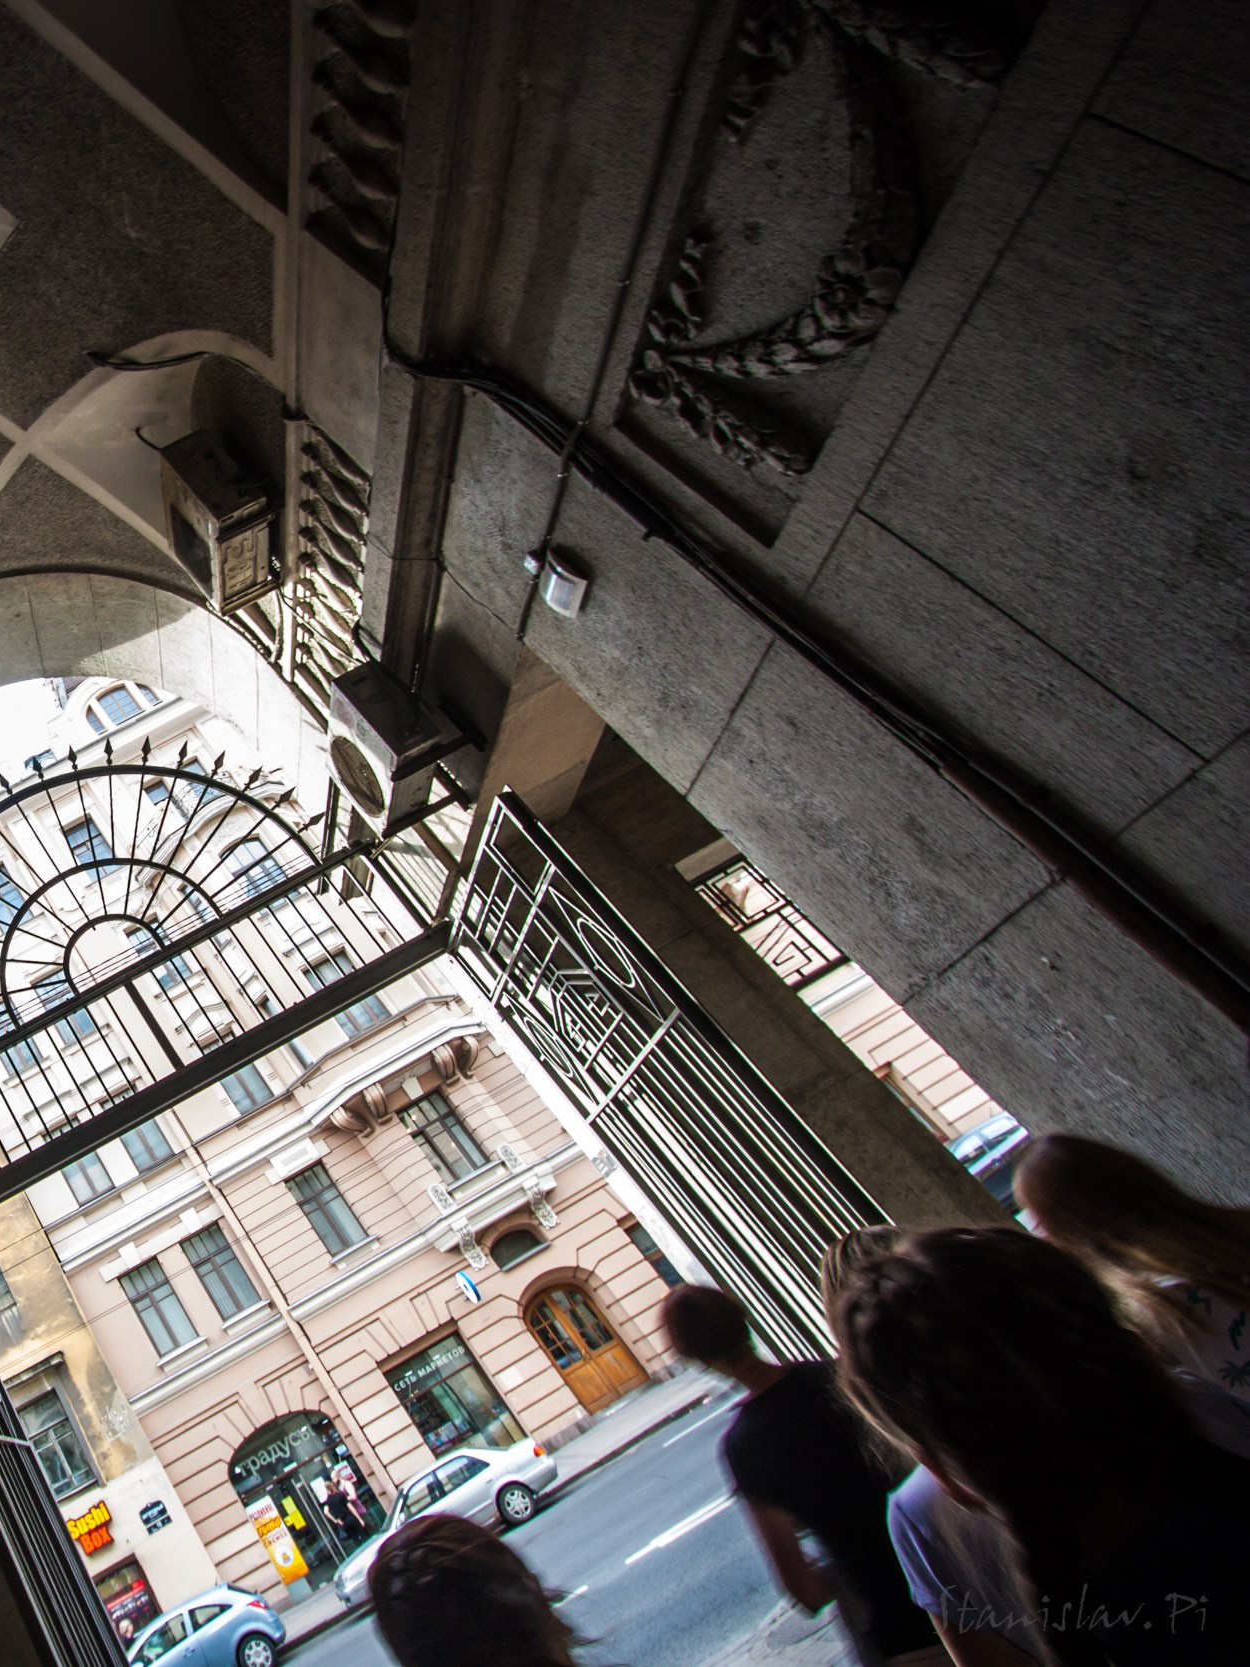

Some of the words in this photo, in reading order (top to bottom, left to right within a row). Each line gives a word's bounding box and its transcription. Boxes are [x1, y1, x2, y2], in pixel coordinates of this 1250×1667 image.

[394, 1374, 417, 1392] СЕТЬ
[417, 1346, 465, 1378] МАРКЕТОВ
[67, 1502, 110, 1539] Sushi
